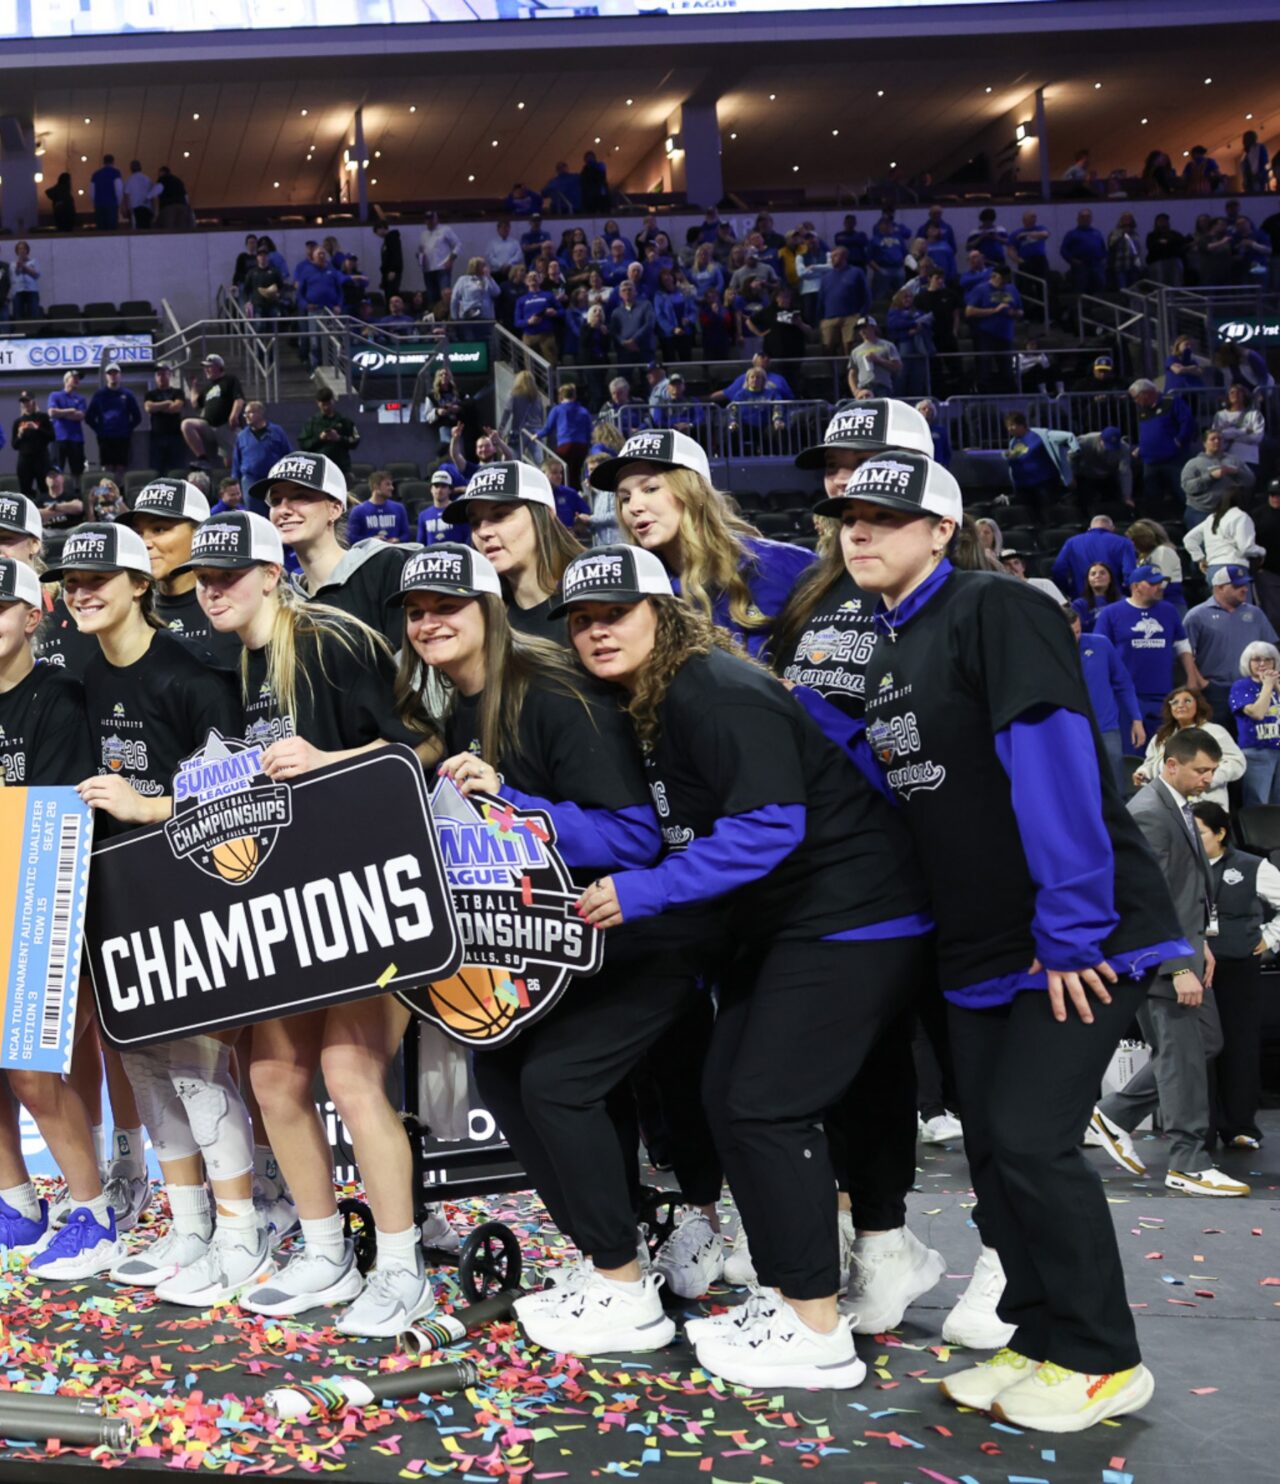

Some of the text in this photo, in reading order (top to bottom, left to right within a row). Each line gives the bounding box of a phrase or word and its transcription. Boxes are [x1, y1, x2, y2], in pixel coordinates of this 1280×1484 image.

[28, 345, 86, 366] COLD
[366, 514, 396, 528] NO QUIT
[404, 561, 462, 580] CHAMPS
[784, 664, 865, 691] Champion
[176, 750, 261, 798] SUMMIT
[182, 757, 203, 770] THE
[199, 779, 248, 803] LEAGUE
[196, 793, 254, 820] BASKETBALL
[43, 822, 55, 852] SEAT
[172, 800, 286, 851] CHAMPIONSHIPS
[439, 823, 546, 866] MMIT
[448, 870, 509, 885] AGUE
[453, 895, 519, 912] ETBALL
[8, 800, 43, 1060] NCAA TOURNAMENT AUTOMATIC QUALIFIER
[34, 897, 48, 945] ROW 15
[101, 854, 434, 1013] CHAMPIONS
[458, 912, 583, 958] ONSHIPS
[465, 952, 520, 964] ALLS, SD
[22, 1001, 37, 1059] SECTION
